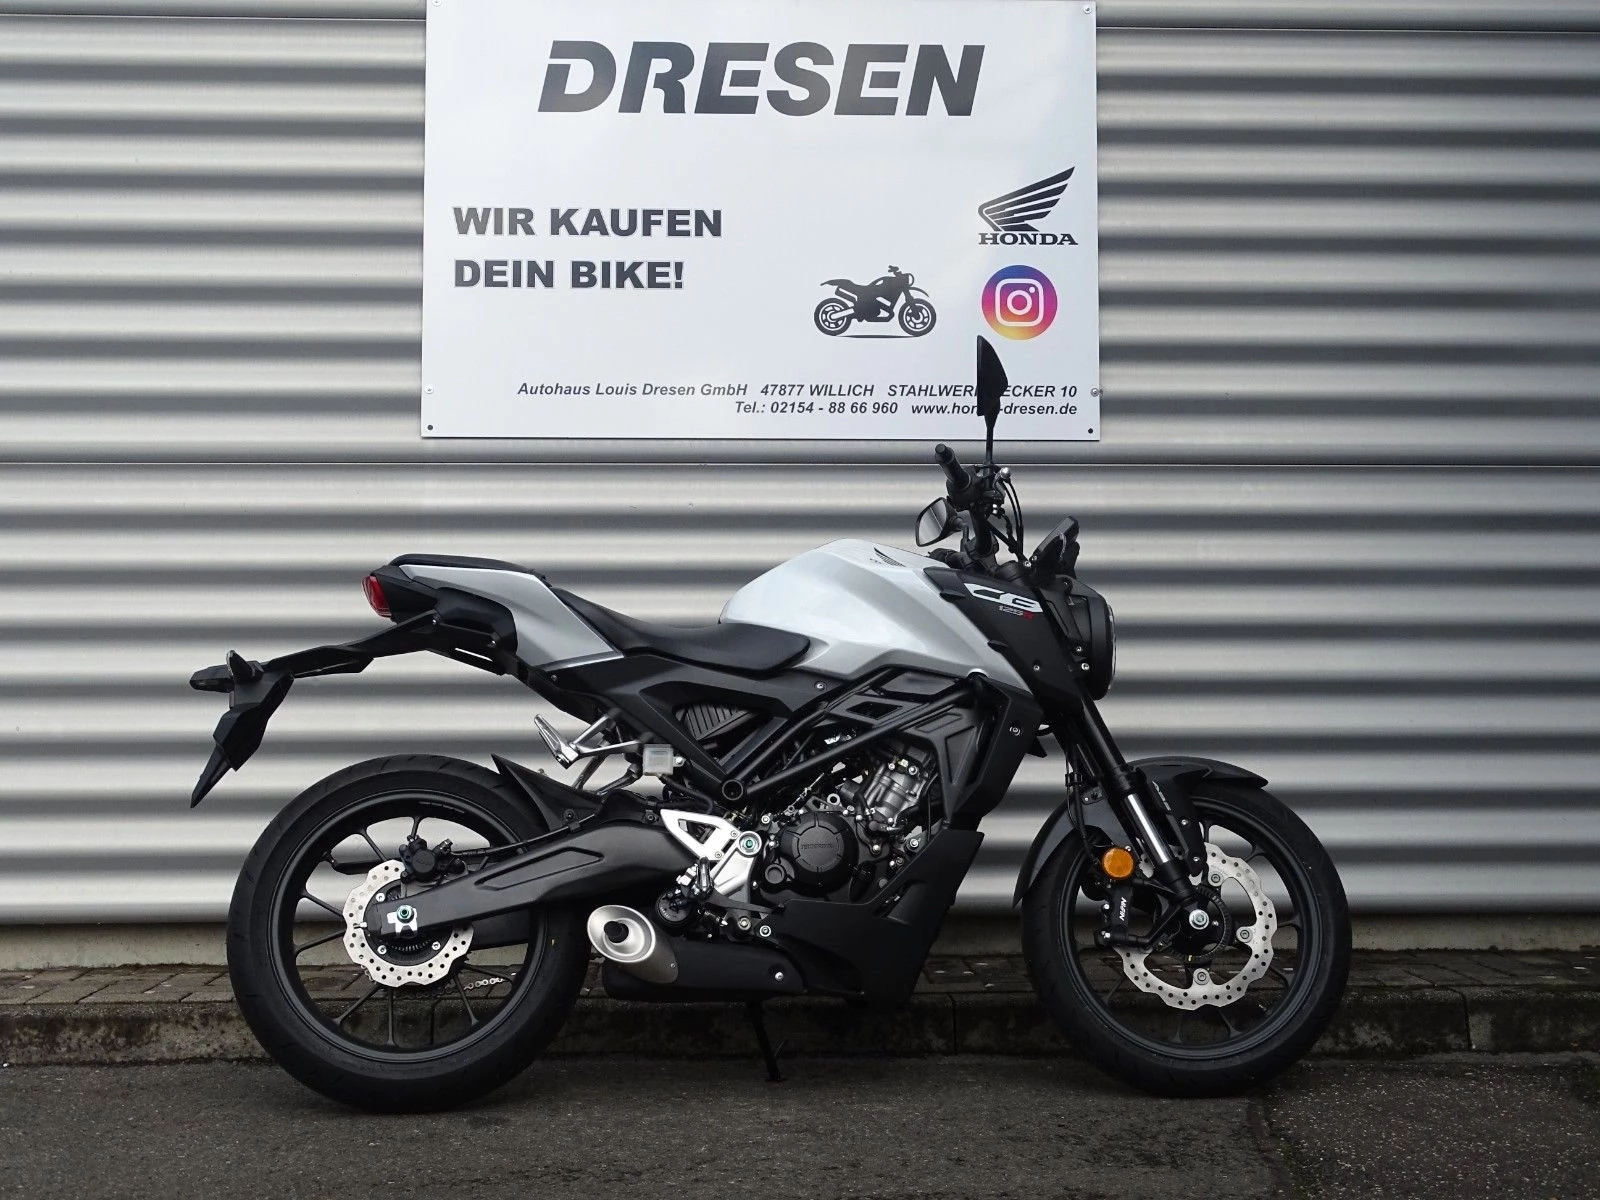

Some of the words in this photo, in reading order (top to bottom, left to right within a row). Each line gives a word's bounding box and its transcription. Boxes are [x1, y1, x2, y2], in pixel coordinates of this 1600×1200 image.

[537, 40, 985, 117] DRESEN
[452, 206, 536, 236] WIR
[550, 208, 722, 238] KAUFEN
[978, 232, 1079, 246] HONDA
[454, 259, 555, 289] DEIN
[571, 260, 685, 290] BIKE!
[517, 382, 591, 396] Autohaus
[595, 382, 638, 396] Louis
[641, 383, 696, 397] Dresen
[700, 383, 748, 397] GmbH
[760, 384, 805, 397] 47877
[809, 384, 875, 397] WILLICH
[887, 384, 979, 398] STAHLWER
[1060, 385, 1078, 398] 10
[735, 401, 766, 414] Tel.:
[770, 401, 815, 414] 02154
[828, 401, 846, 414] 88
[850, 401, 868, 414] 66
[871, 401, 899, 415] 960
